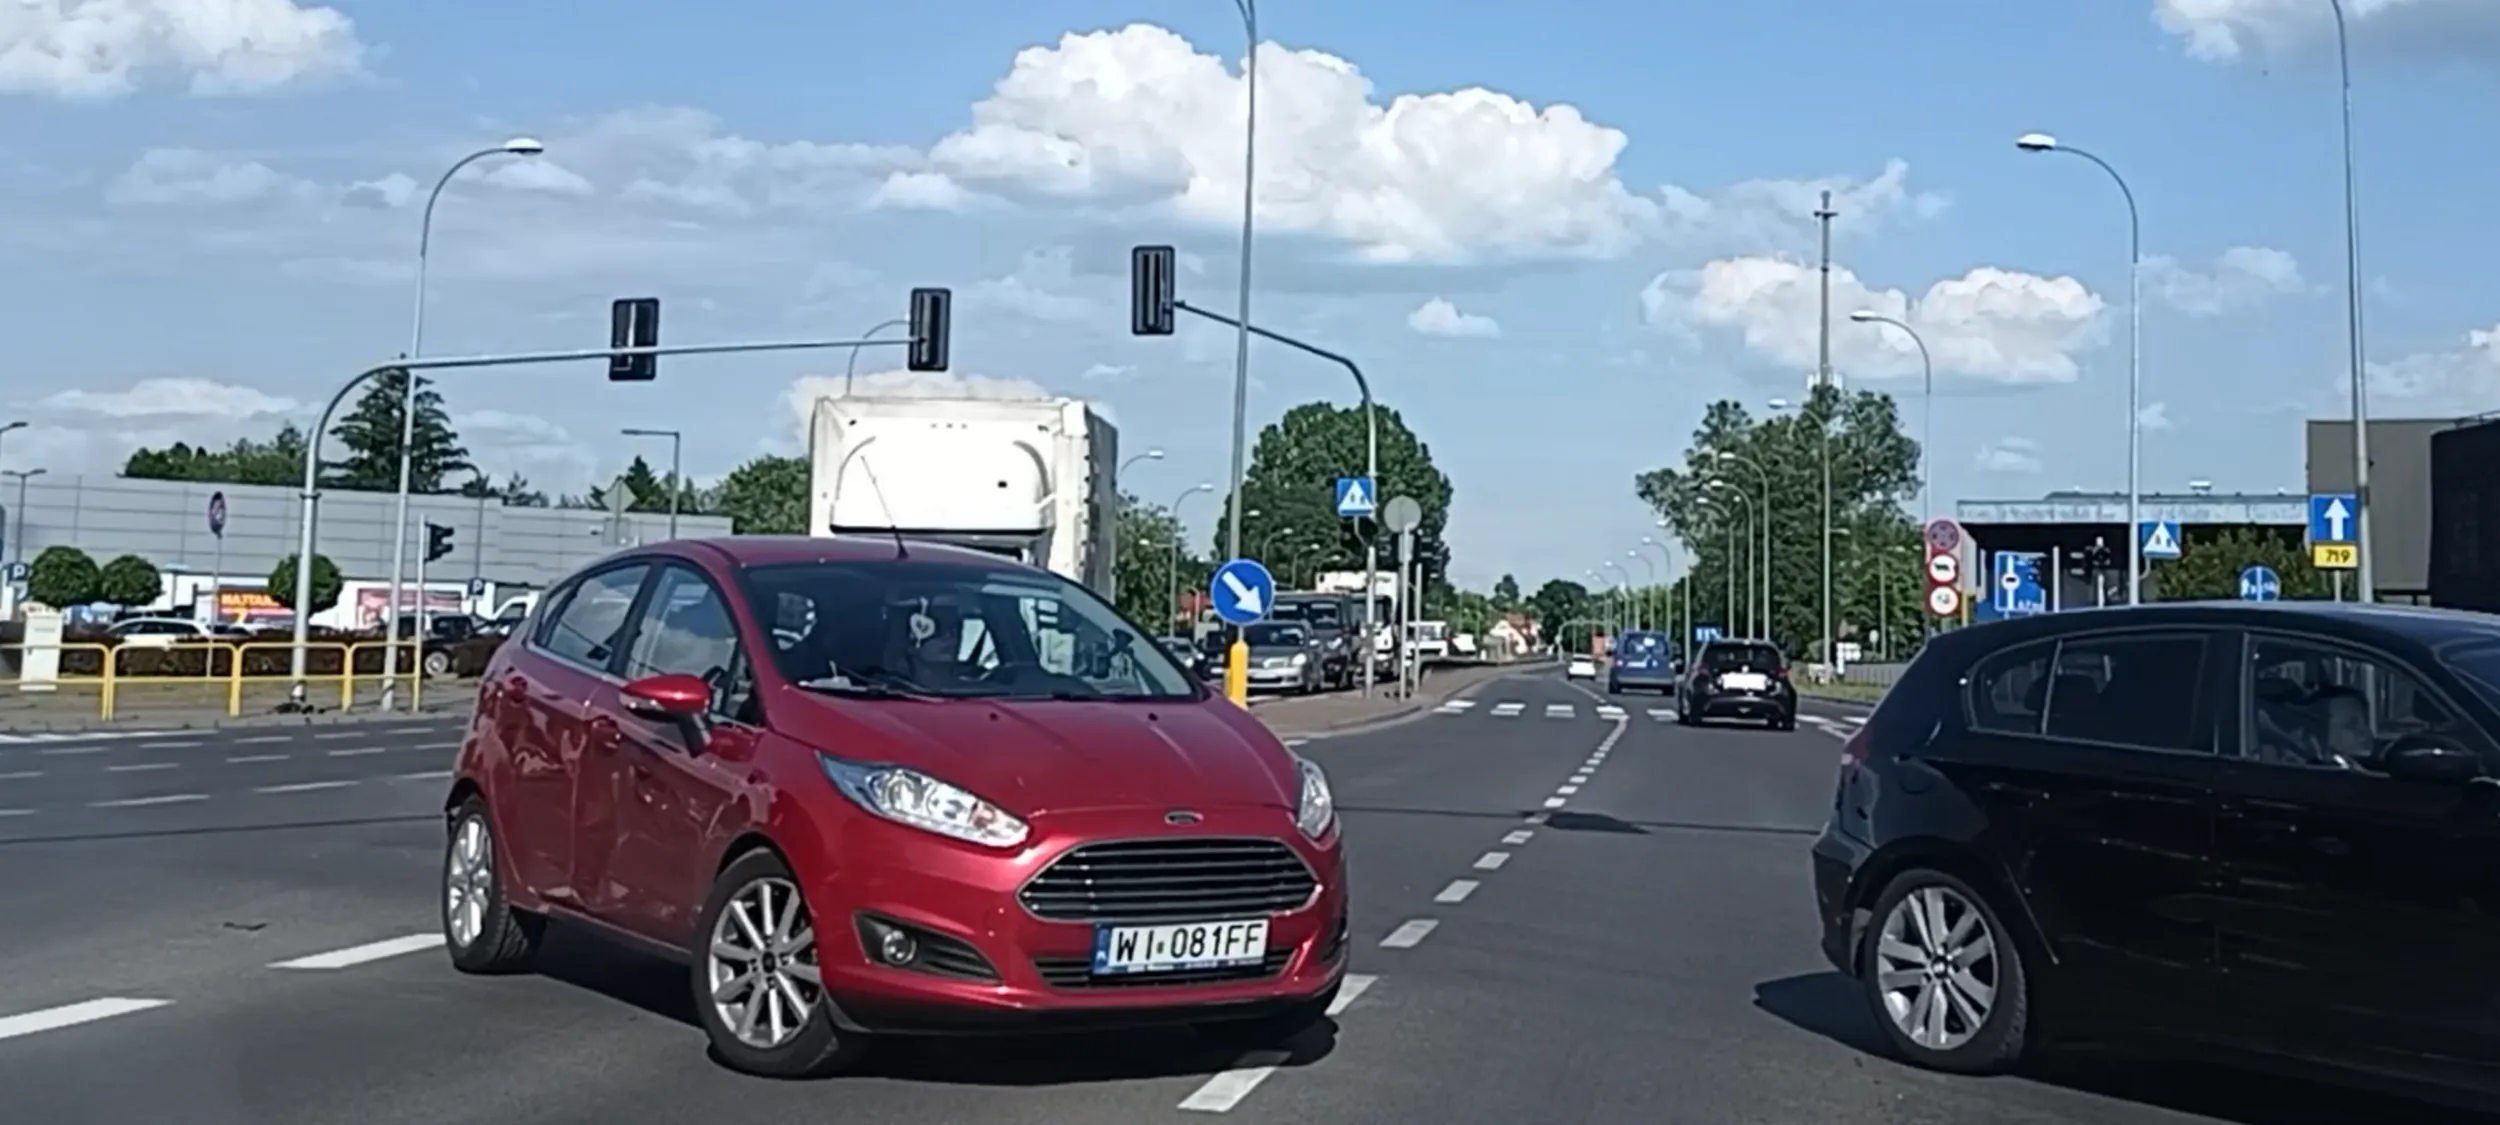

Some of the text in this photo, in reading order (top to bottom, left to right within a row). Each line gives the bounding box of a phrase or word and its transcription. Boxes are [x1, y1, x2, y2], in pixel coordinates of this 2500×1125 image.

[2326, 549, 2351, 563] 719
[13, 564, 26, 579] P
[1116, 923, 1263, 962] WI 081FF
